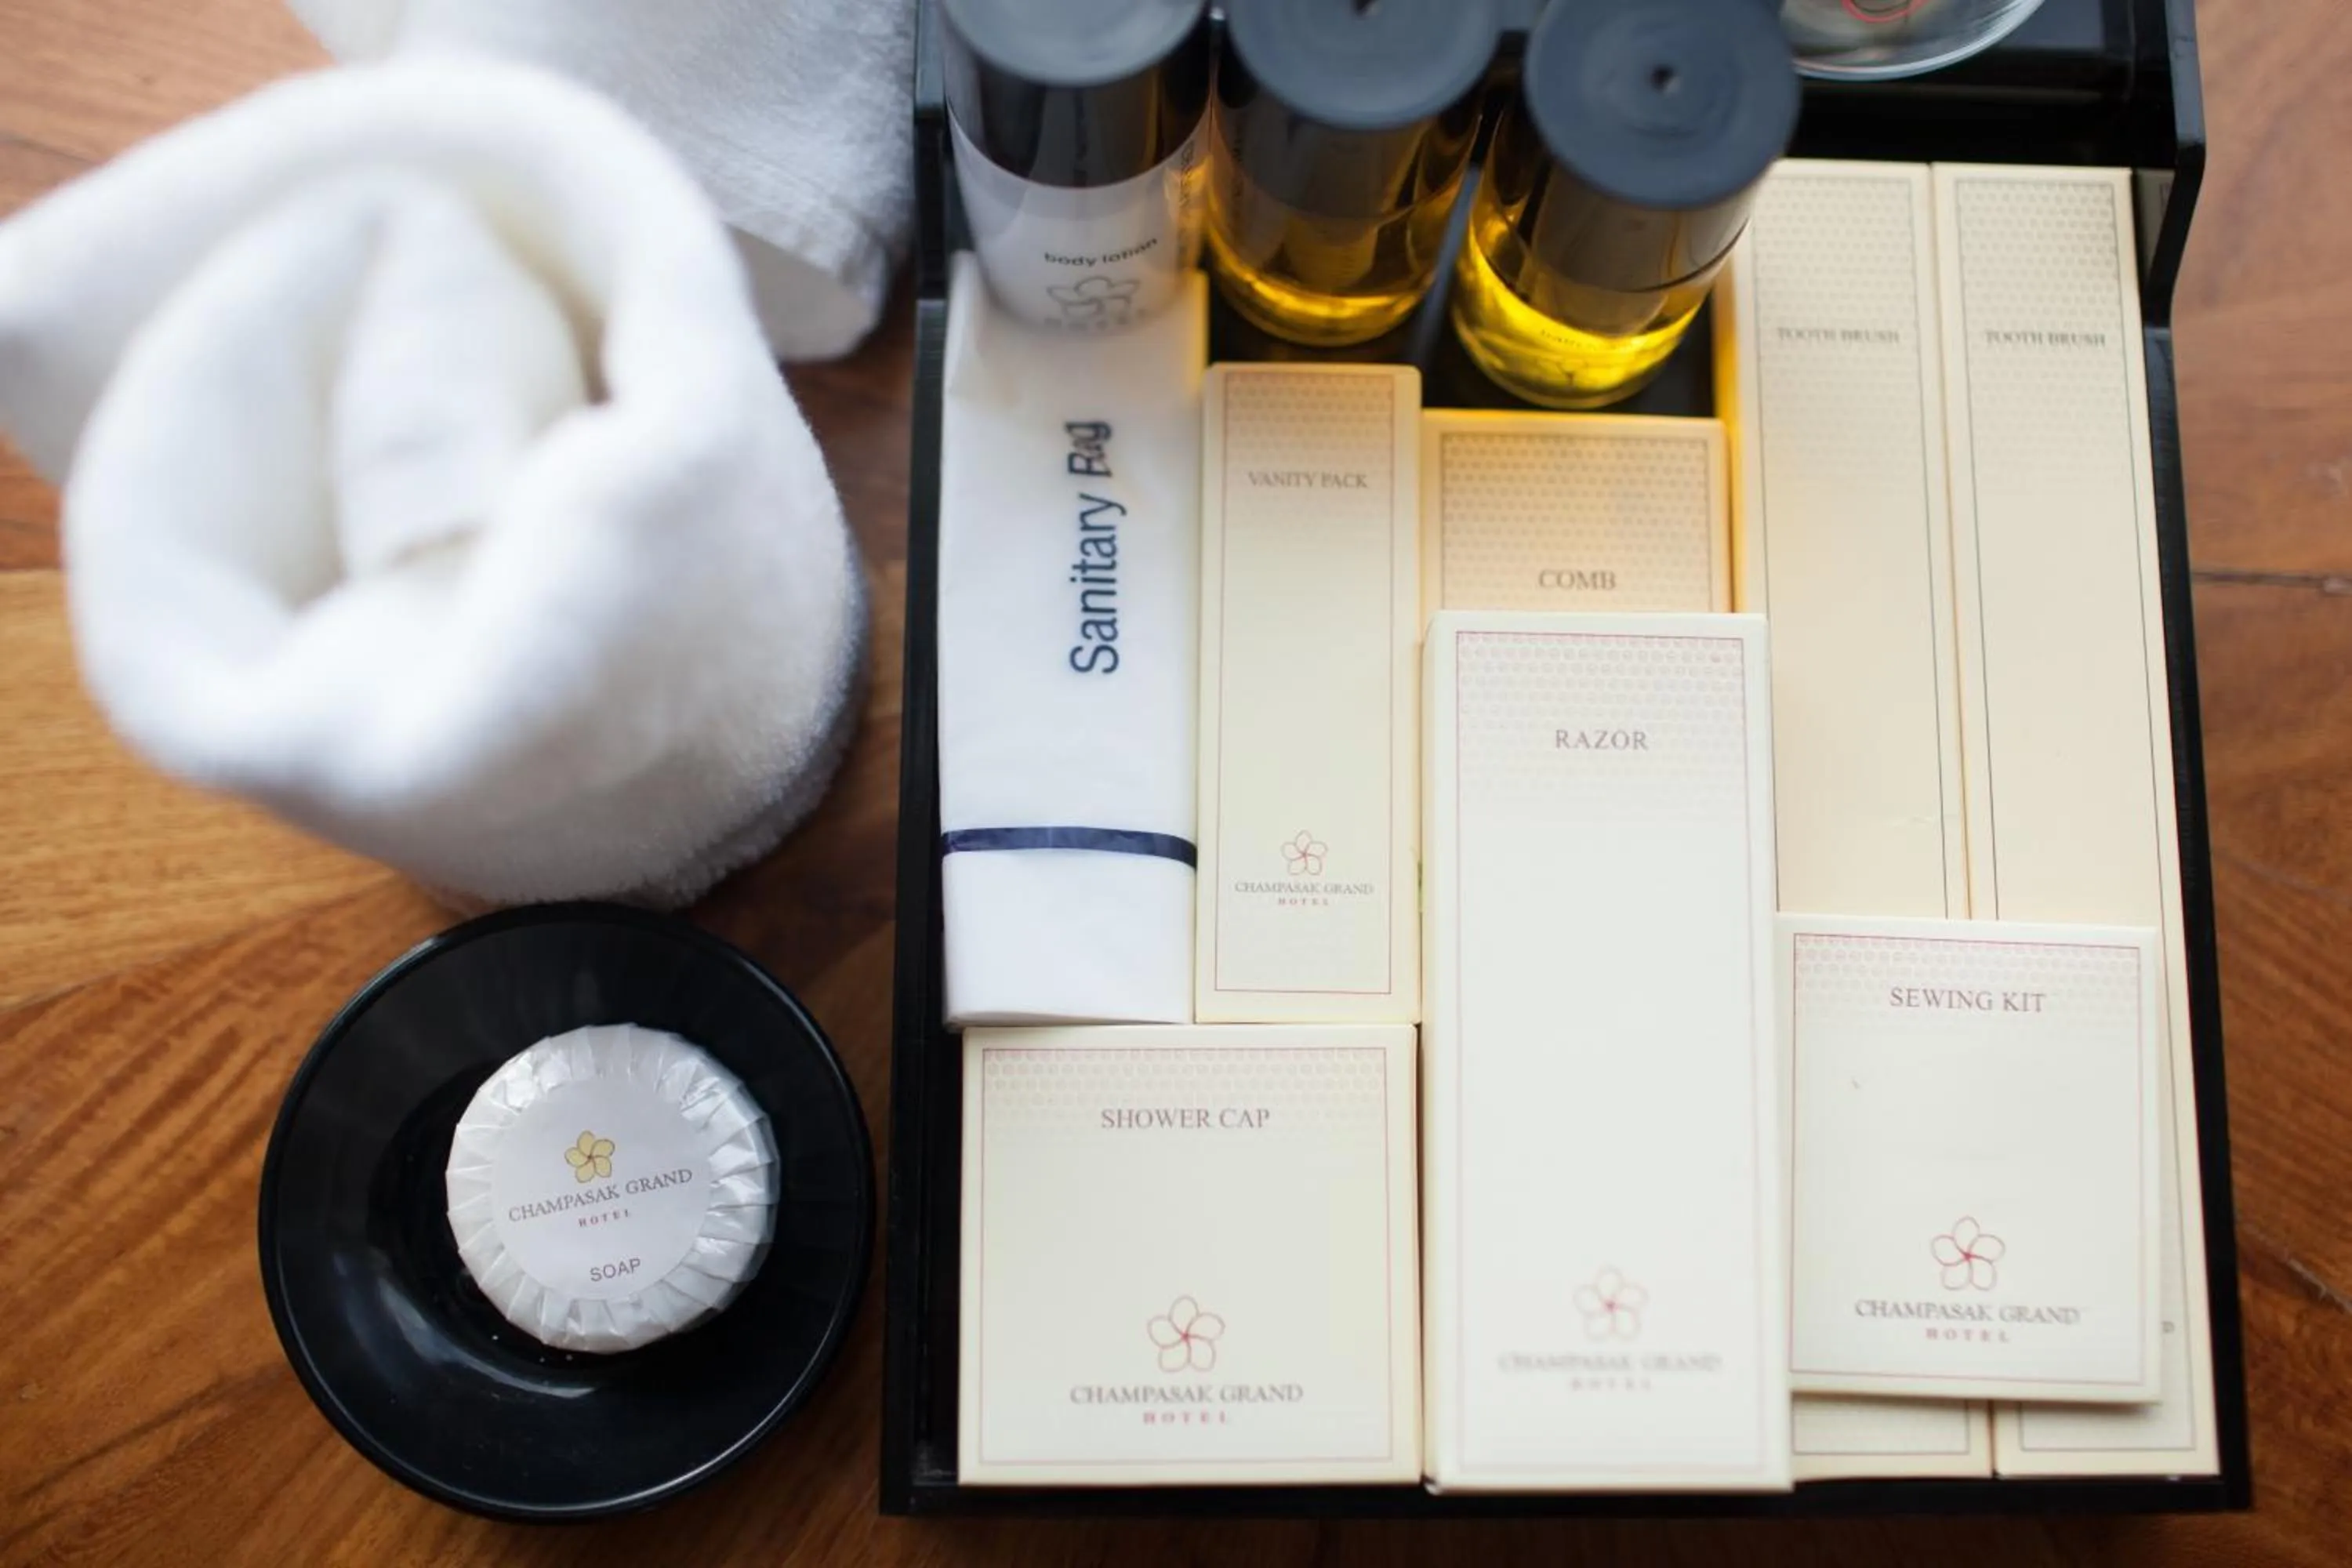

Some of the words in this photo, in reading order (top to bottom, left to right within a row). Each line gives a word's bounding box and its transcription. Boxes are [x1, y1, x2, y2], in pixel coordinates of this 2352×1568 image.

[1044, 252, 1097, 267] body
[1102, 238, 1157, 264] lotion
[1777, 327, 1836, 343] TOOTH
[1840, 328, 1900, 344] BRUSH
[1984, 329, 2043, 345] TOOTH
[2047, 330, 2107, 347] BRUSH
[1248, 470, 1319, 488] VANITY
[1321, 471, 1369, 489] PACK
[1069, 492, 1127, 674] Sanitary
[1538, 568, 1617, 591] COMB
[1555, 728, 1649, 751] RAZOR
[1234, 880, 1321, 894] CHAMPASAK
[1323, 882, 1375, 895] GRAND
[1278, 897, 1330, 906] HOTEL
[1889, 986, 1994, 1011] SEWING
[2002, 991, 2048, 1013] KIT
[1101, 1107, 1211, 1130] SHOWER
[1218, 1107, 1271, 1130] CAP
[508, 1184, 620, 1223] CHAMPASAK
[625, 1167, 694, 1195] GRAND
[578, 1210, 632, 1228] HOTEL
[589, 1258, 642, 1283] SOAP
[1854, 1298, 1994, 1322] CHAMPASAK
[1999, 1305, 2082, 1325] GRAND
[1926, 1327, 2011, 1344] HOTEL
[1069, 1384, 1214, 1404] CHAMPASAK
[1218, 1383, 1305, 1403] GRAND
[1142, 1410, 1230, 1425] HOTEL
